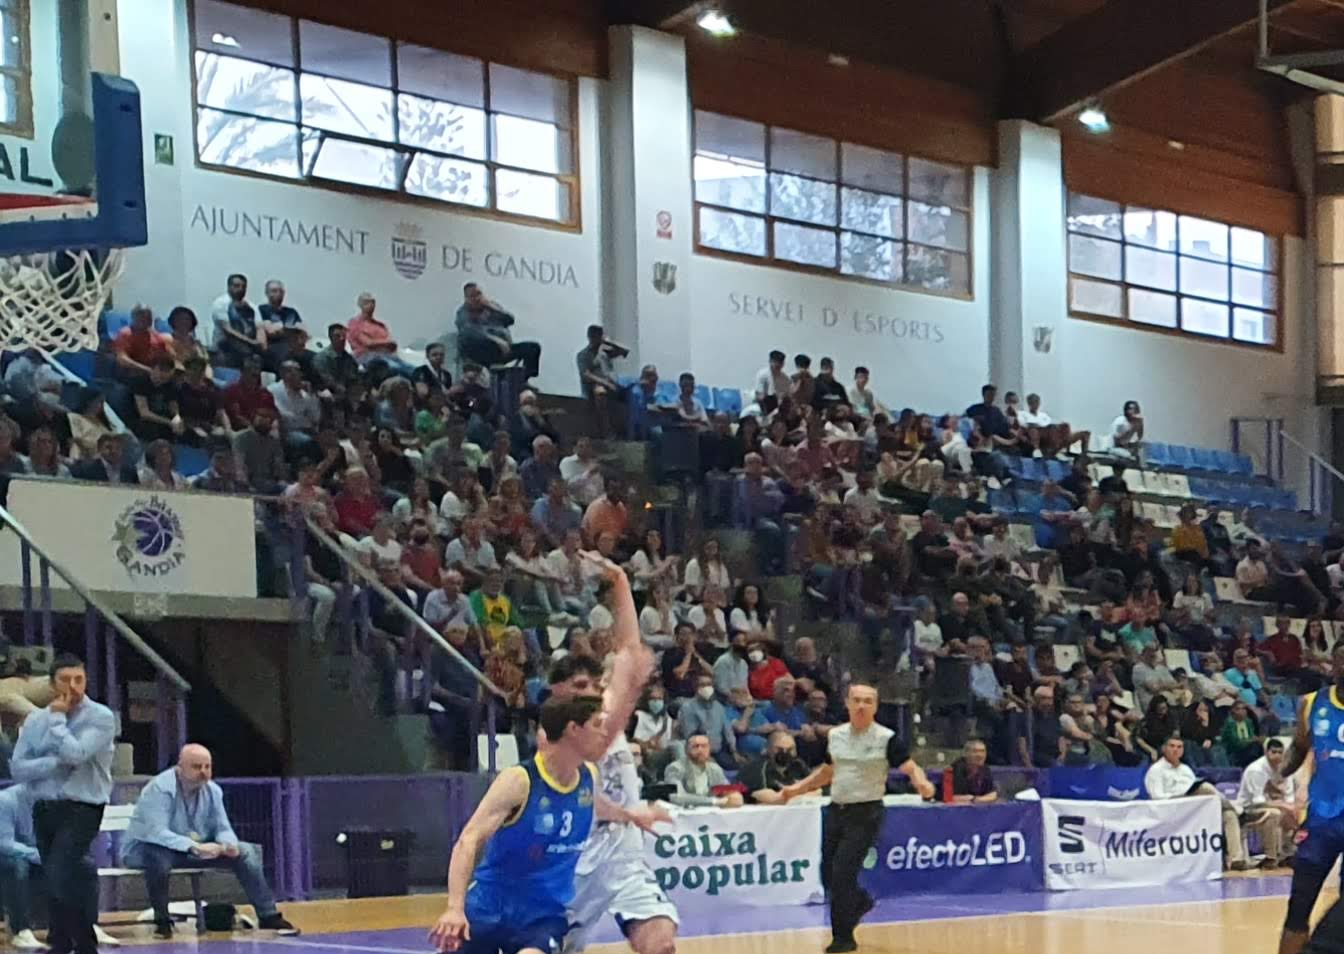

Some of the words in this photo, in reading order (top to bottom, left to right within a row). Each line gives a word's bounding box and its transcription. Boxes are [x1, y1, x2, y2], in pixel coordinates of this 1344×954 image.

[191, 204, 369, 256] AJUNTAMENT
[442, 246, 472, 272] DE
[484, 254, 578, 288] GANDIA
[730, 293, 803, 322] SERVEI
[853, 311, 945, 343] ESPORTS
[559, 811, 573, 837] 3
[654, 826, 756, 858] caixa
[886, 831, 1026, 870] efectoLED
[1105, 829, 1226, 859] Miferauto
[654, 853, 810, 895] popular
